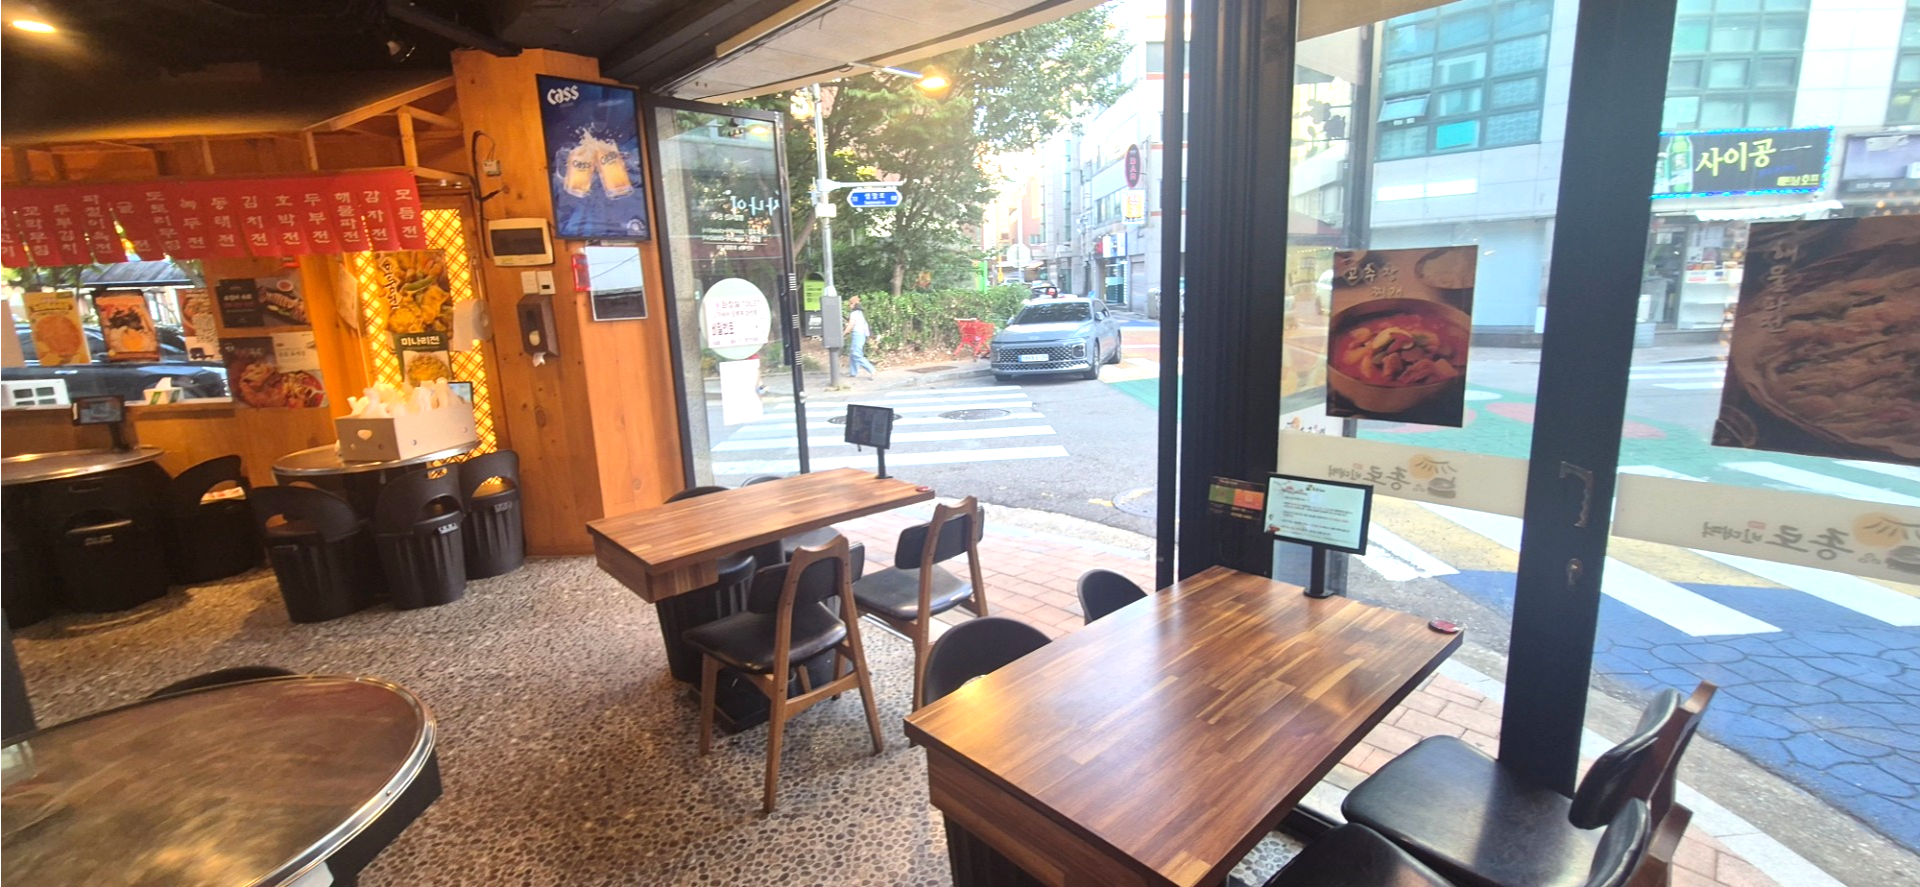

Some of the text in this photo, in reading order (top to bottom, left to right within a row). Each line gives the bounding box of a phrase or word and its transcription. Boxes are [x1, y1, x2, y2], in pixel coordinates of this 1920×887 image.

[1129, 157, 1138, 180] BAR
[1695, 138, 1777, 176] 사이공
[53, 204, 77, 254] 두부김치
[180, 198, 205, 248] 녹두전
[211, 197, 235, 247] 동태전
[241, 195, 268, 246] 김치전
[275, 194, 301, 245] 호박전
[304, 193, 331, 243] 두부전
[335, 191, 360, 242] 해물파전
[363, 190, 389, 241] 감자전
[395, 189, 418, 238] 모듬전
[1347, 262, 1399, 283] 고추장
[401, 335, 440, 346] 미나리전
